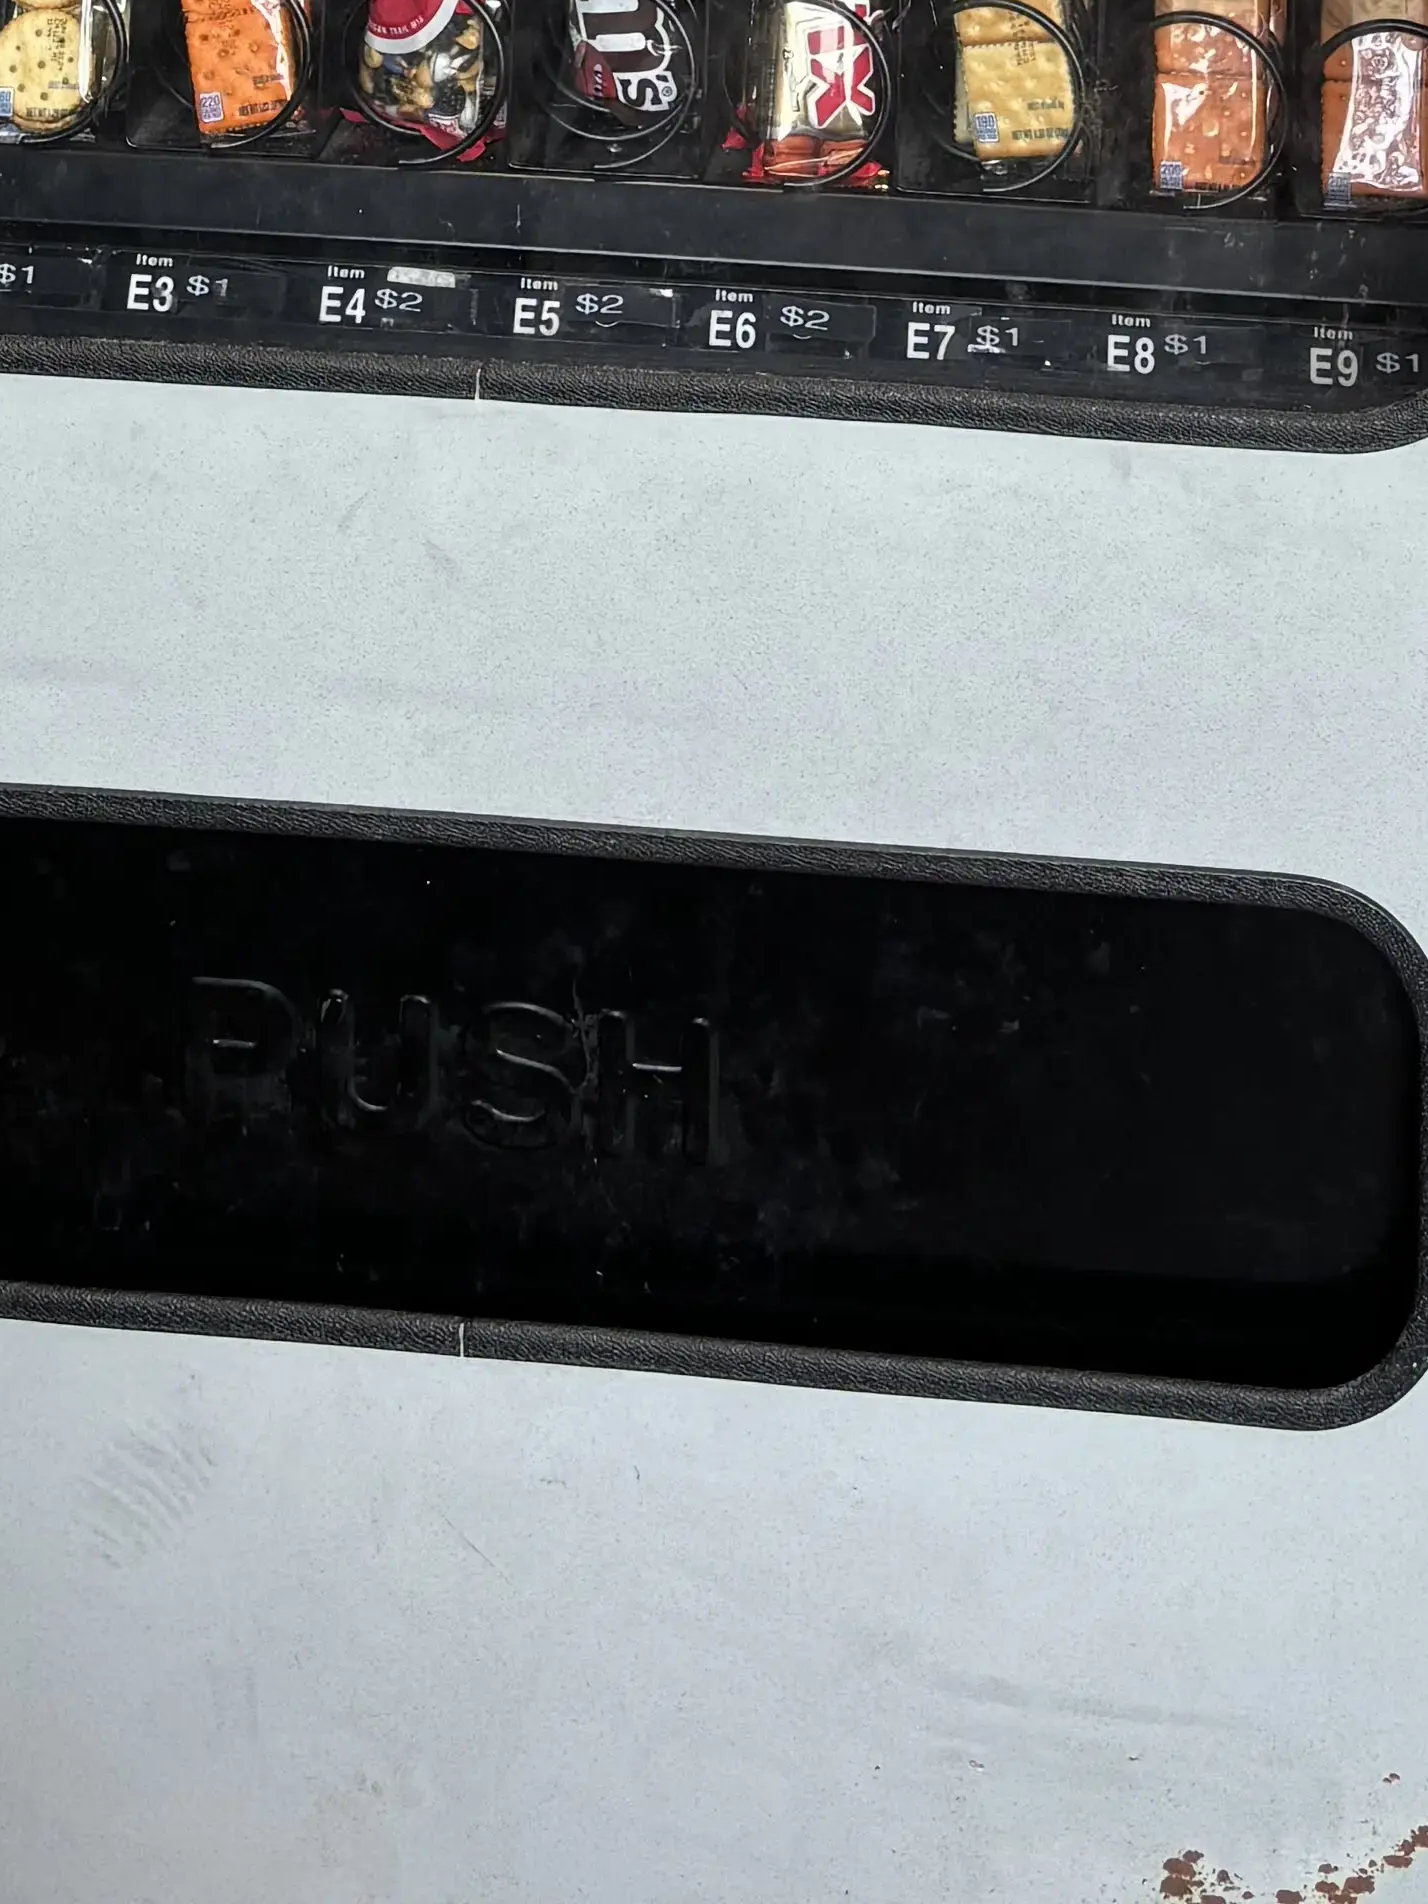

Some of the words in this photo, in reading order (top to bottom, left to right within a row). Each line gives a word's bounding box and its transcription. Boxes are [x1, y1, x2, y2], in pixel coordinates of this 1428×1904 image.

[127, 273, 174, 312] E3
[318, 284, 366, 324] E4
[513, 296, 559, 336] E5
[576, 292, 624, 315] $2
[708, 309, 756, 348] E6
[906, 321, 957, 361] E7
[1106, 335, 1155, 374] E8
[1309, 347, 1359, 387] E9
[191, 974, 721, 1166] PUSH
